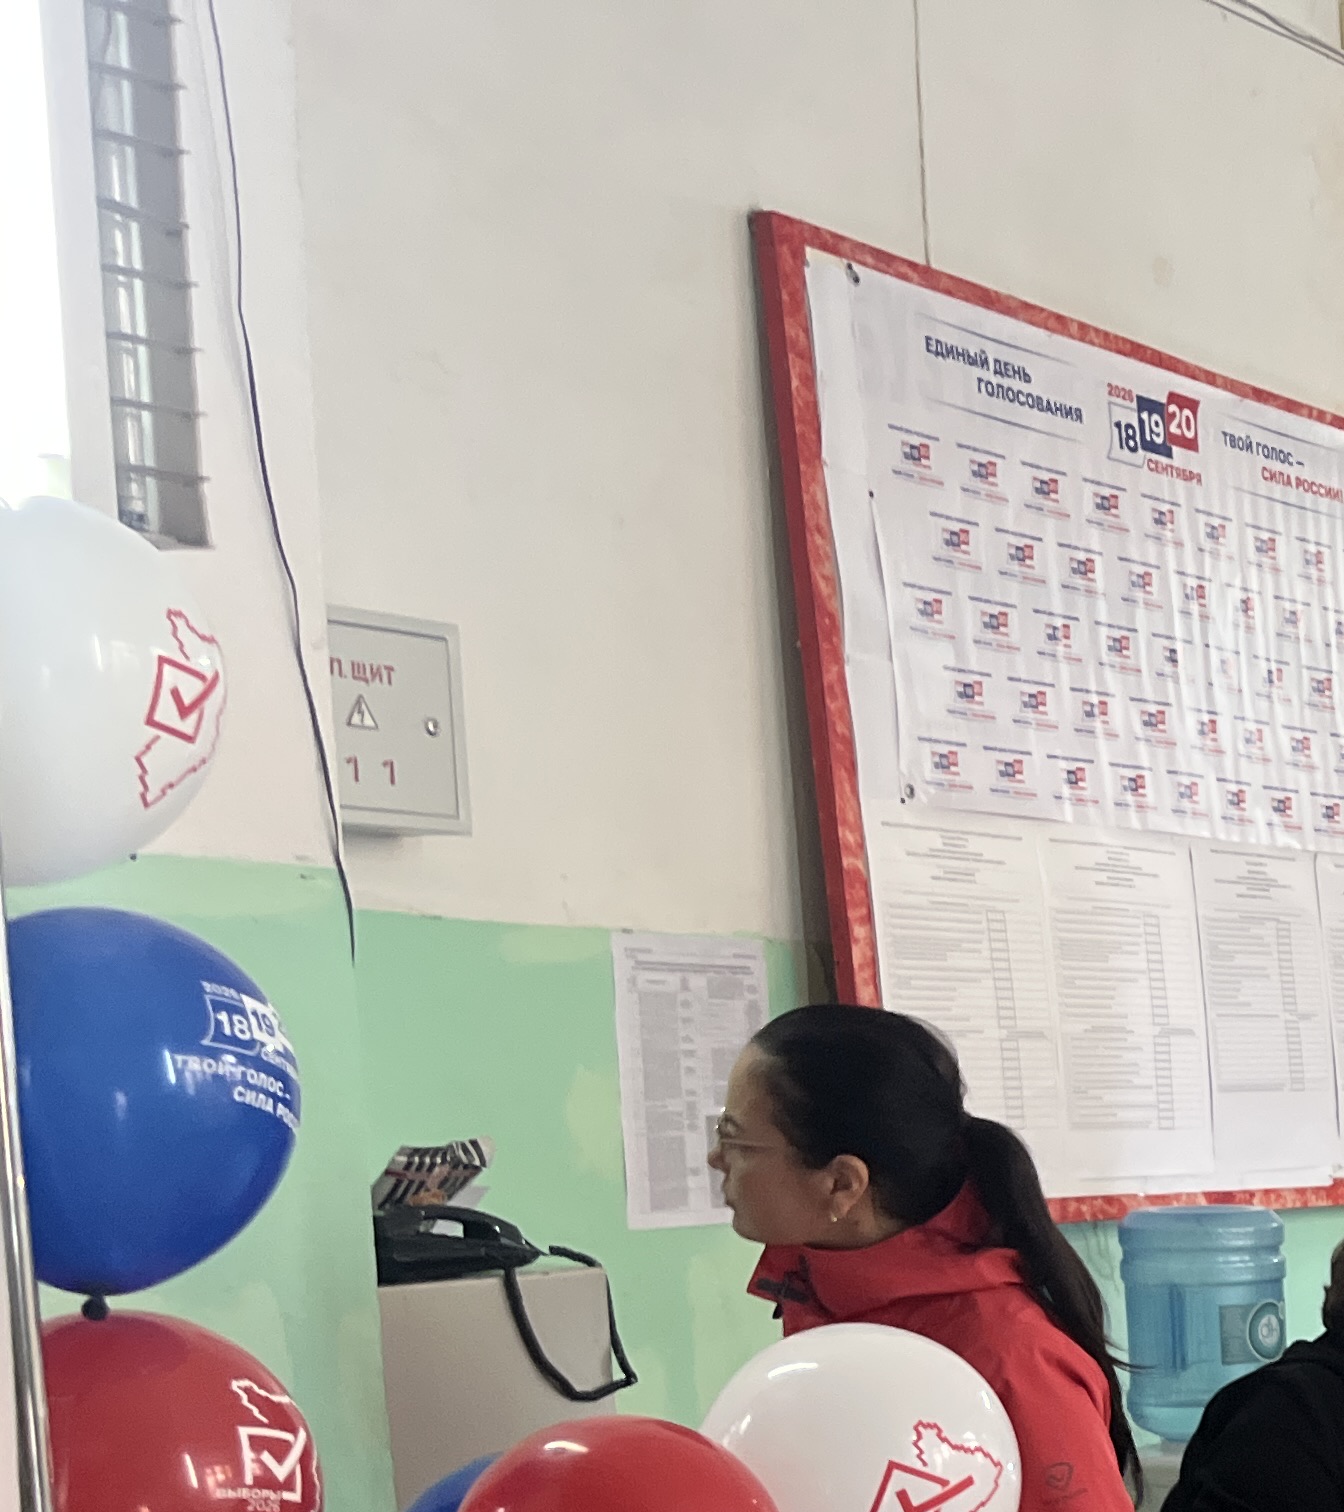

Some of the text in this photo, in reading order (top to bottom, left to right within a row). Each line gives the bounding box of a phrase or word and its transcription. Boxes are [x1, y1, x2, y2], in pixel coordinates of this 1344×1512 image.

[924, 334, 1033, 385] ЕДИНЫЙ ДЕНЬ
[976, 375, 1084, 425] ГОЛОСОВАНИЯ
[1107, 382, 1134, 403] 2026
[1113, 403, 1196, 454] 18 19 20
[1222, 430, 1254, 455] ТВОЙ
[1255, 443, 1295, 468] ГОЛОС
[1146, 457, 1203, 487] СЕНТЯБРЯ
[1261, 465, 1344, 503] СИЛА РОССИИ!
[350, 660, 395, 687] ЩИТ
[216, 1008, 276, 1041] 18 19
